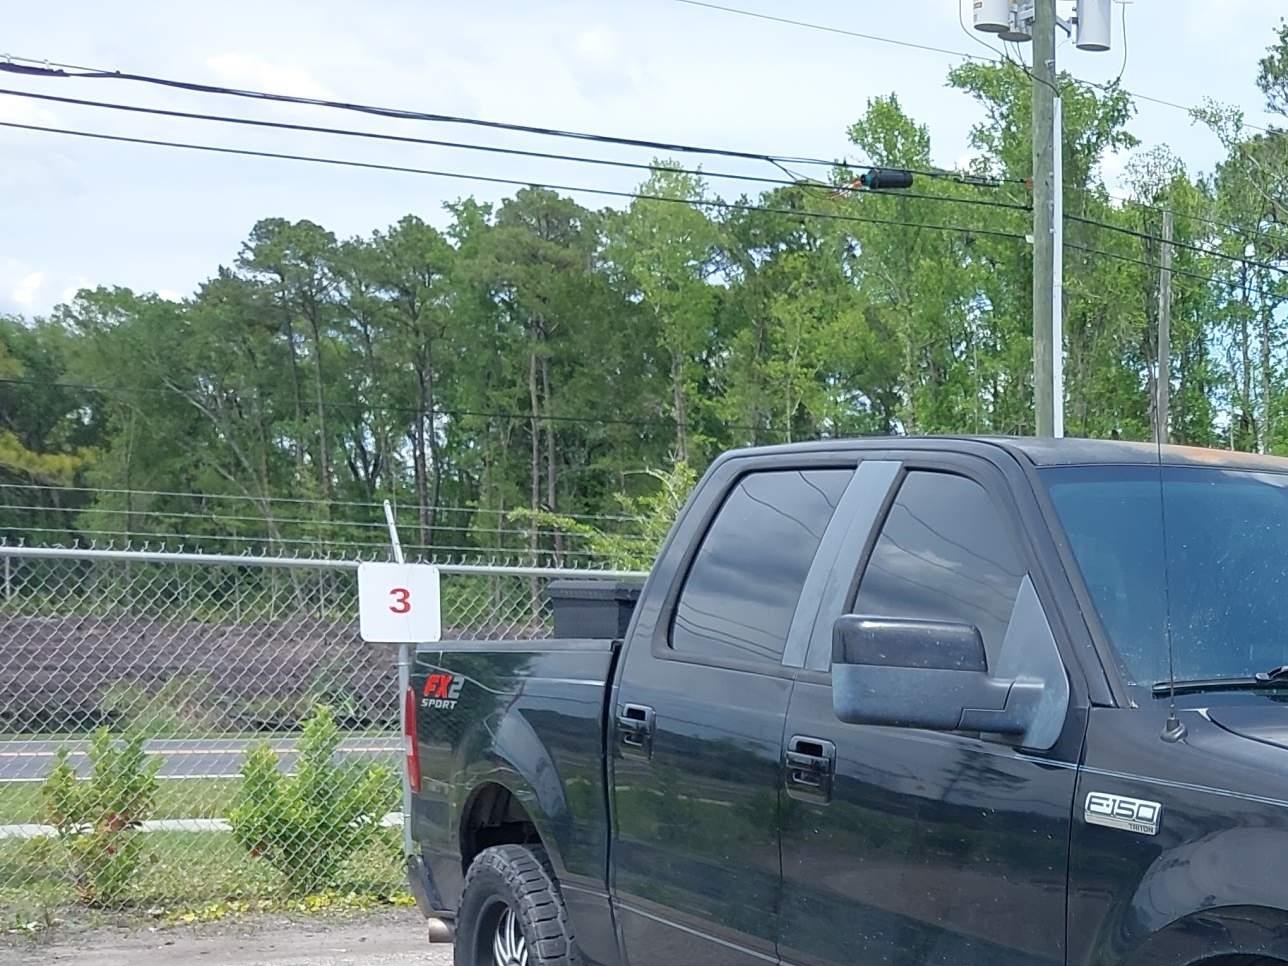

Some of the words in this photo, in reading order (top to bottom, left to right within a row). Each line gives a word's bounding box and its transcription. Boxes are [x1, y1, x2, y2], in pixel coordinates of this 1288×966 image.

[389, 588, 411, 613] 3
[423, 673, 465, 699] FX2
[421, 698, 458, 710] SPORT
[1087, 795, 1157, 822] F-150
